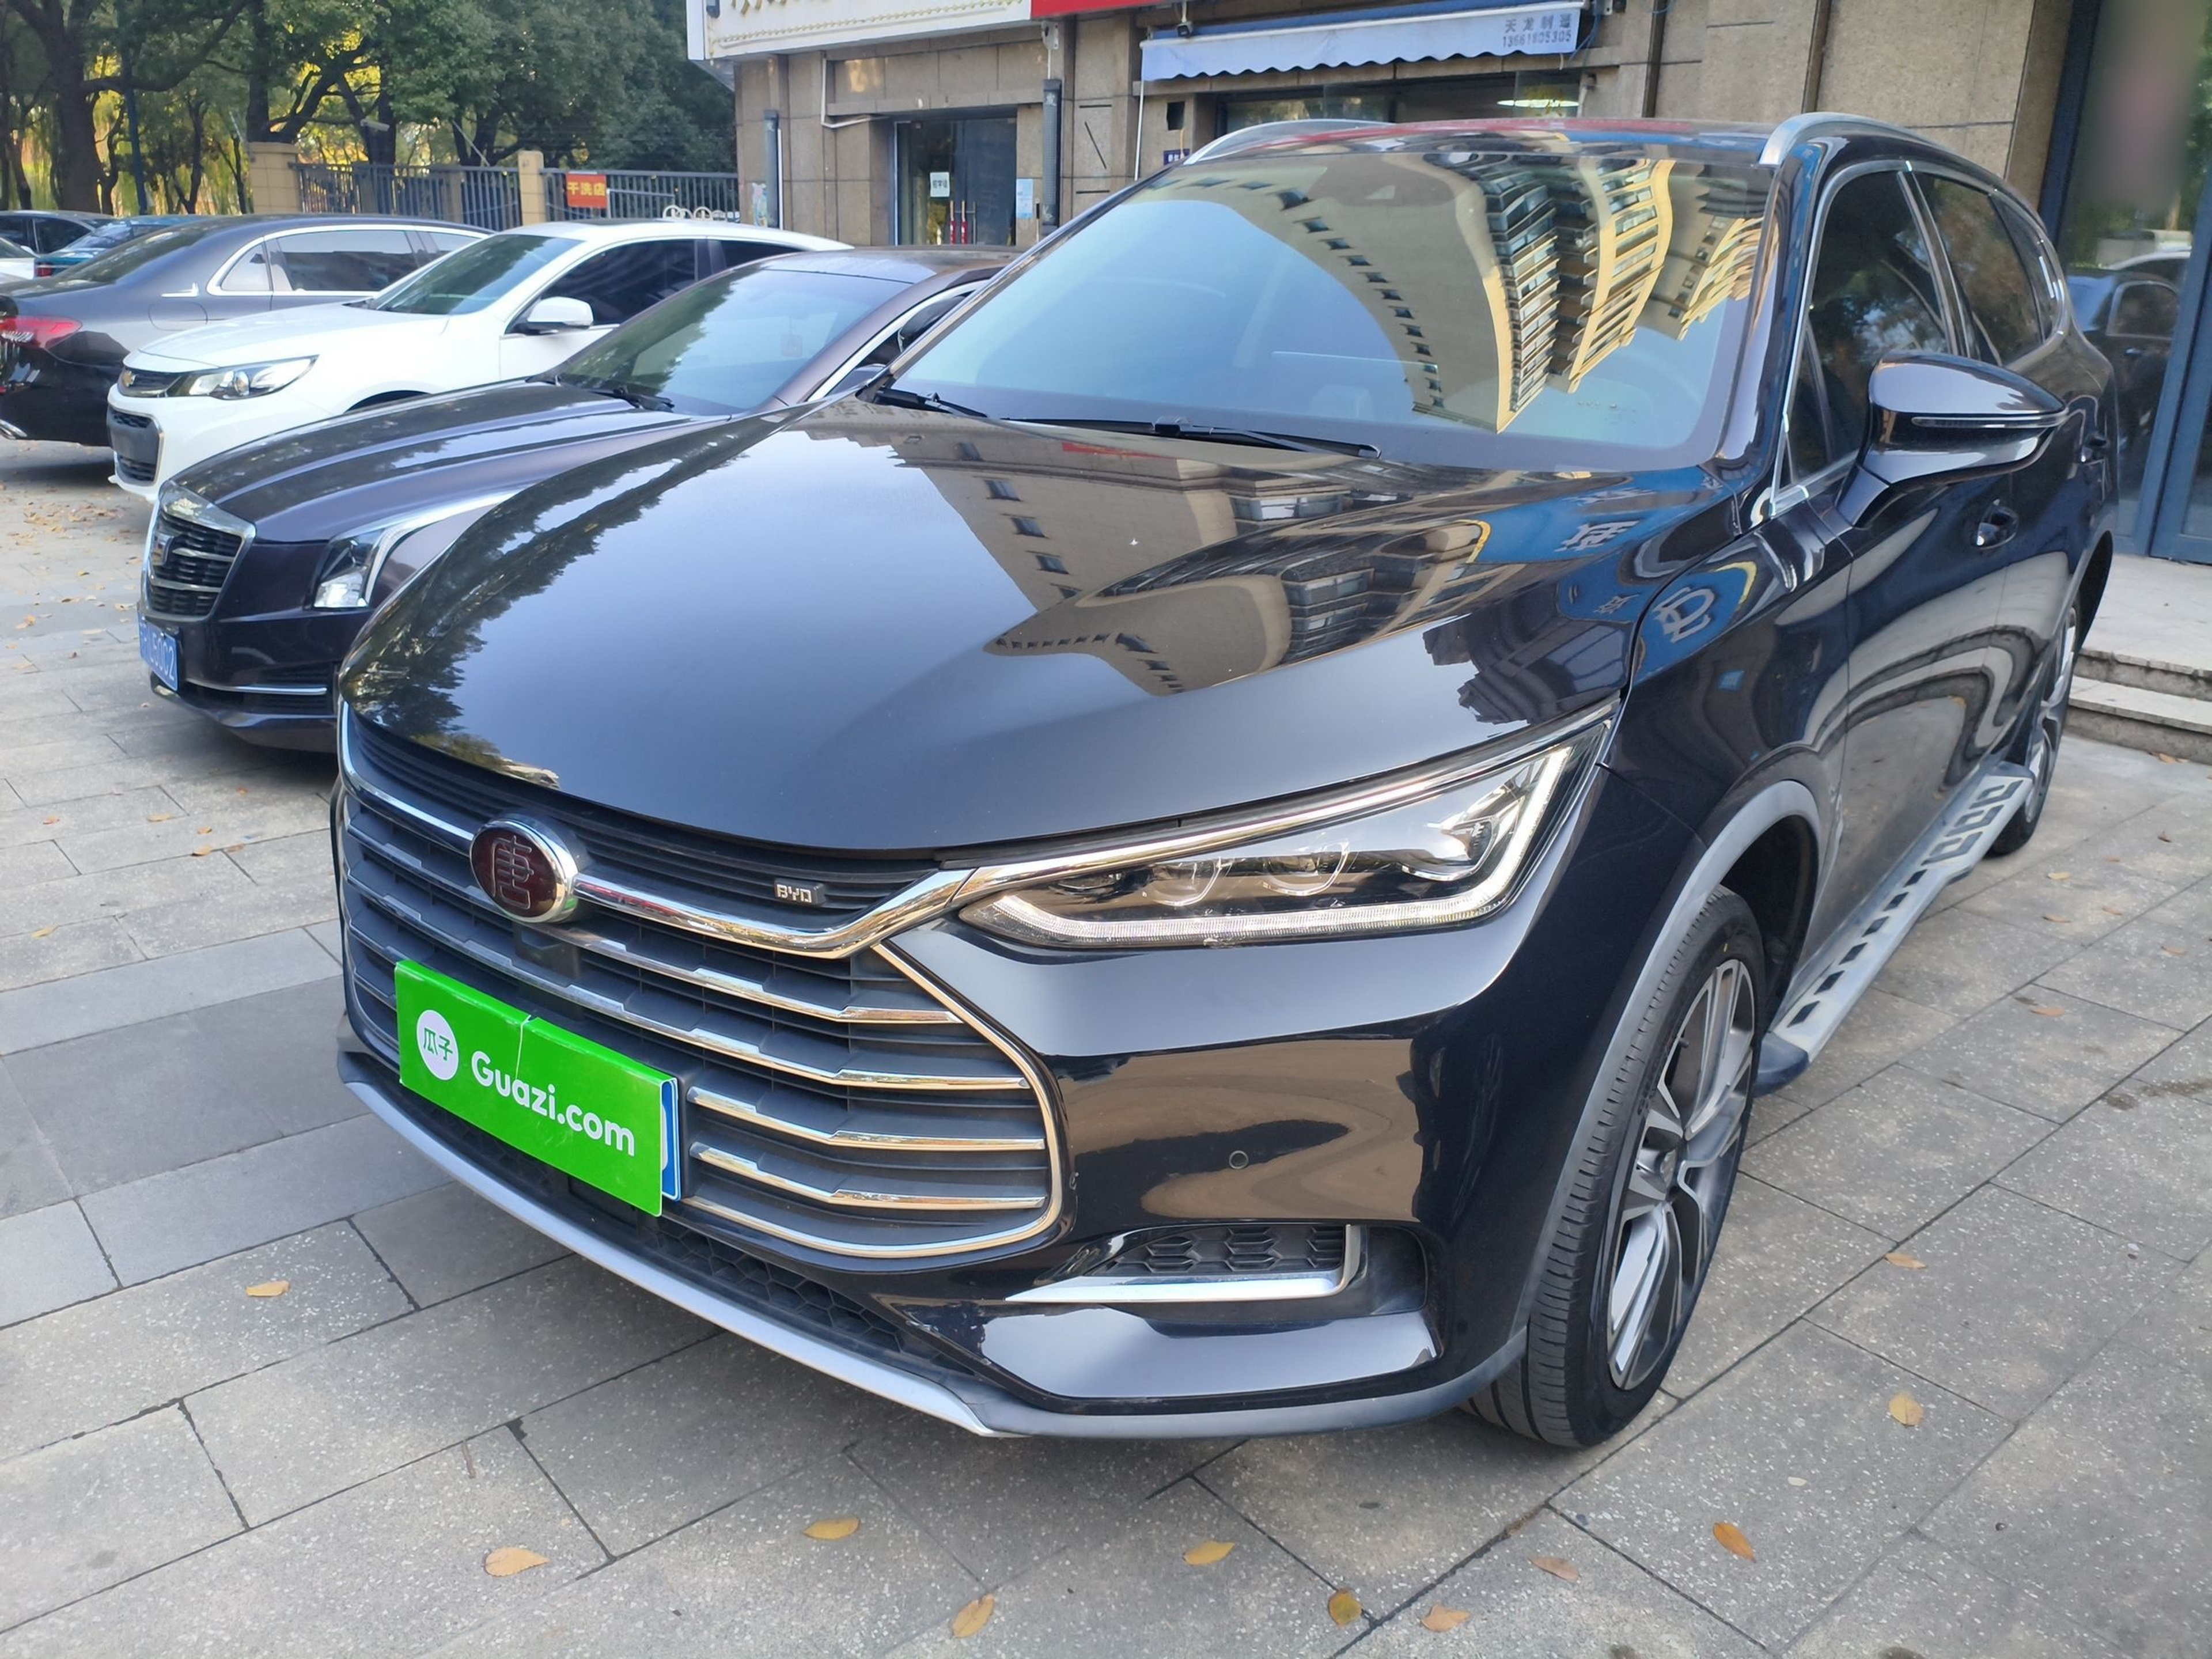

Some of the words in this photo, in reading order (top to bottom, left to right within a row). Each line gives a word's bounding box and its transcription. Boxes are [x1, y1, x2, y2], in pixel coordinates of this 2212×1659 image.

[567, 181, 606, 196] 干洗店
[491, 835, 535, 910] 唐
[777, 884, 812, 903] BYD
[423, 1027, 453, 1061] 瓜子
[471, 1050, 635, 1157] Guazi.com
